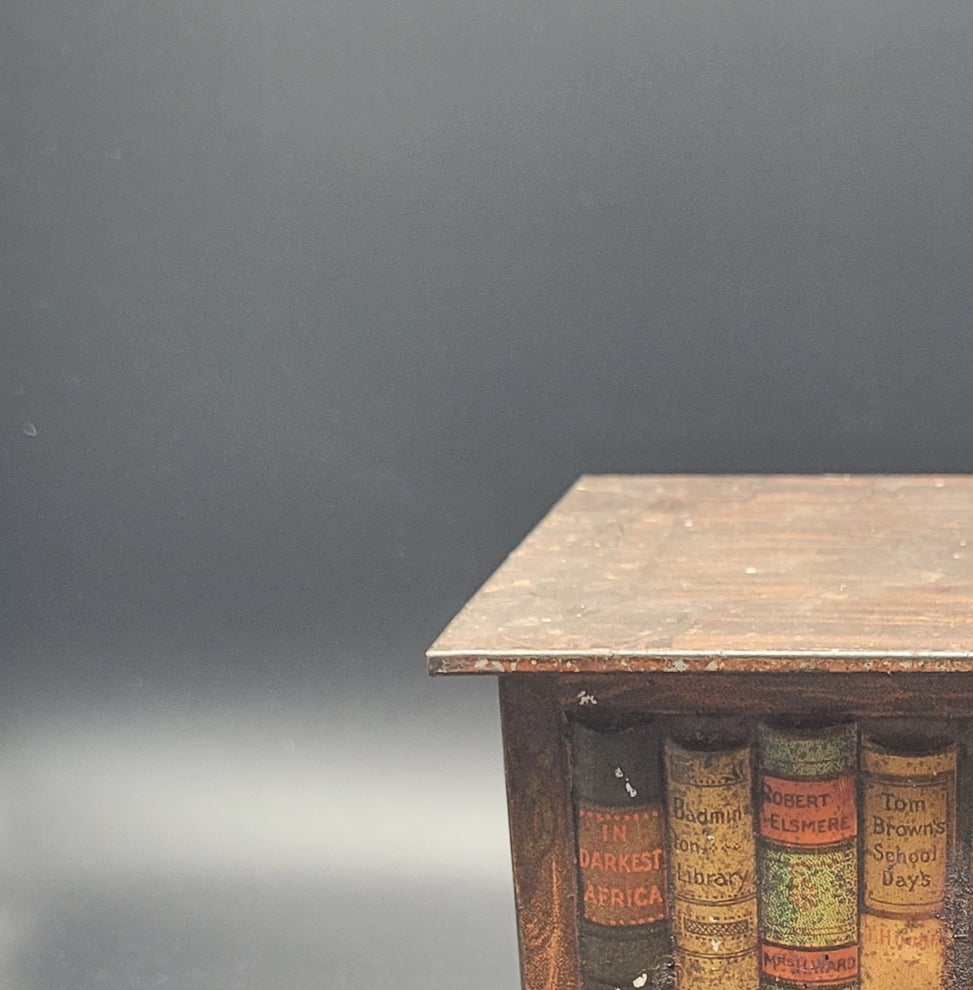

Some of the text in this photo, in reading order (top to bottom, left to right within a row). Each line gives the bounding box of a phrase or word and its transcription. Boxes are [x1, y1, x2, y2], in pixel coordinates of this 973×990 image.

[762, 781, 829, 809] ROBERT
[882, 792, 927, 813] Tom
[602, 824, 627, 842] IN
[873, 815, 946, 838] Brown's
[579, 847, 663, 874] DARKEST
[873, 842, 937, 864] School
[677, 861, 749, 894] Library
[882, 869, 932, 892] Day's
[583, 883, 664, 908] AFRICA
